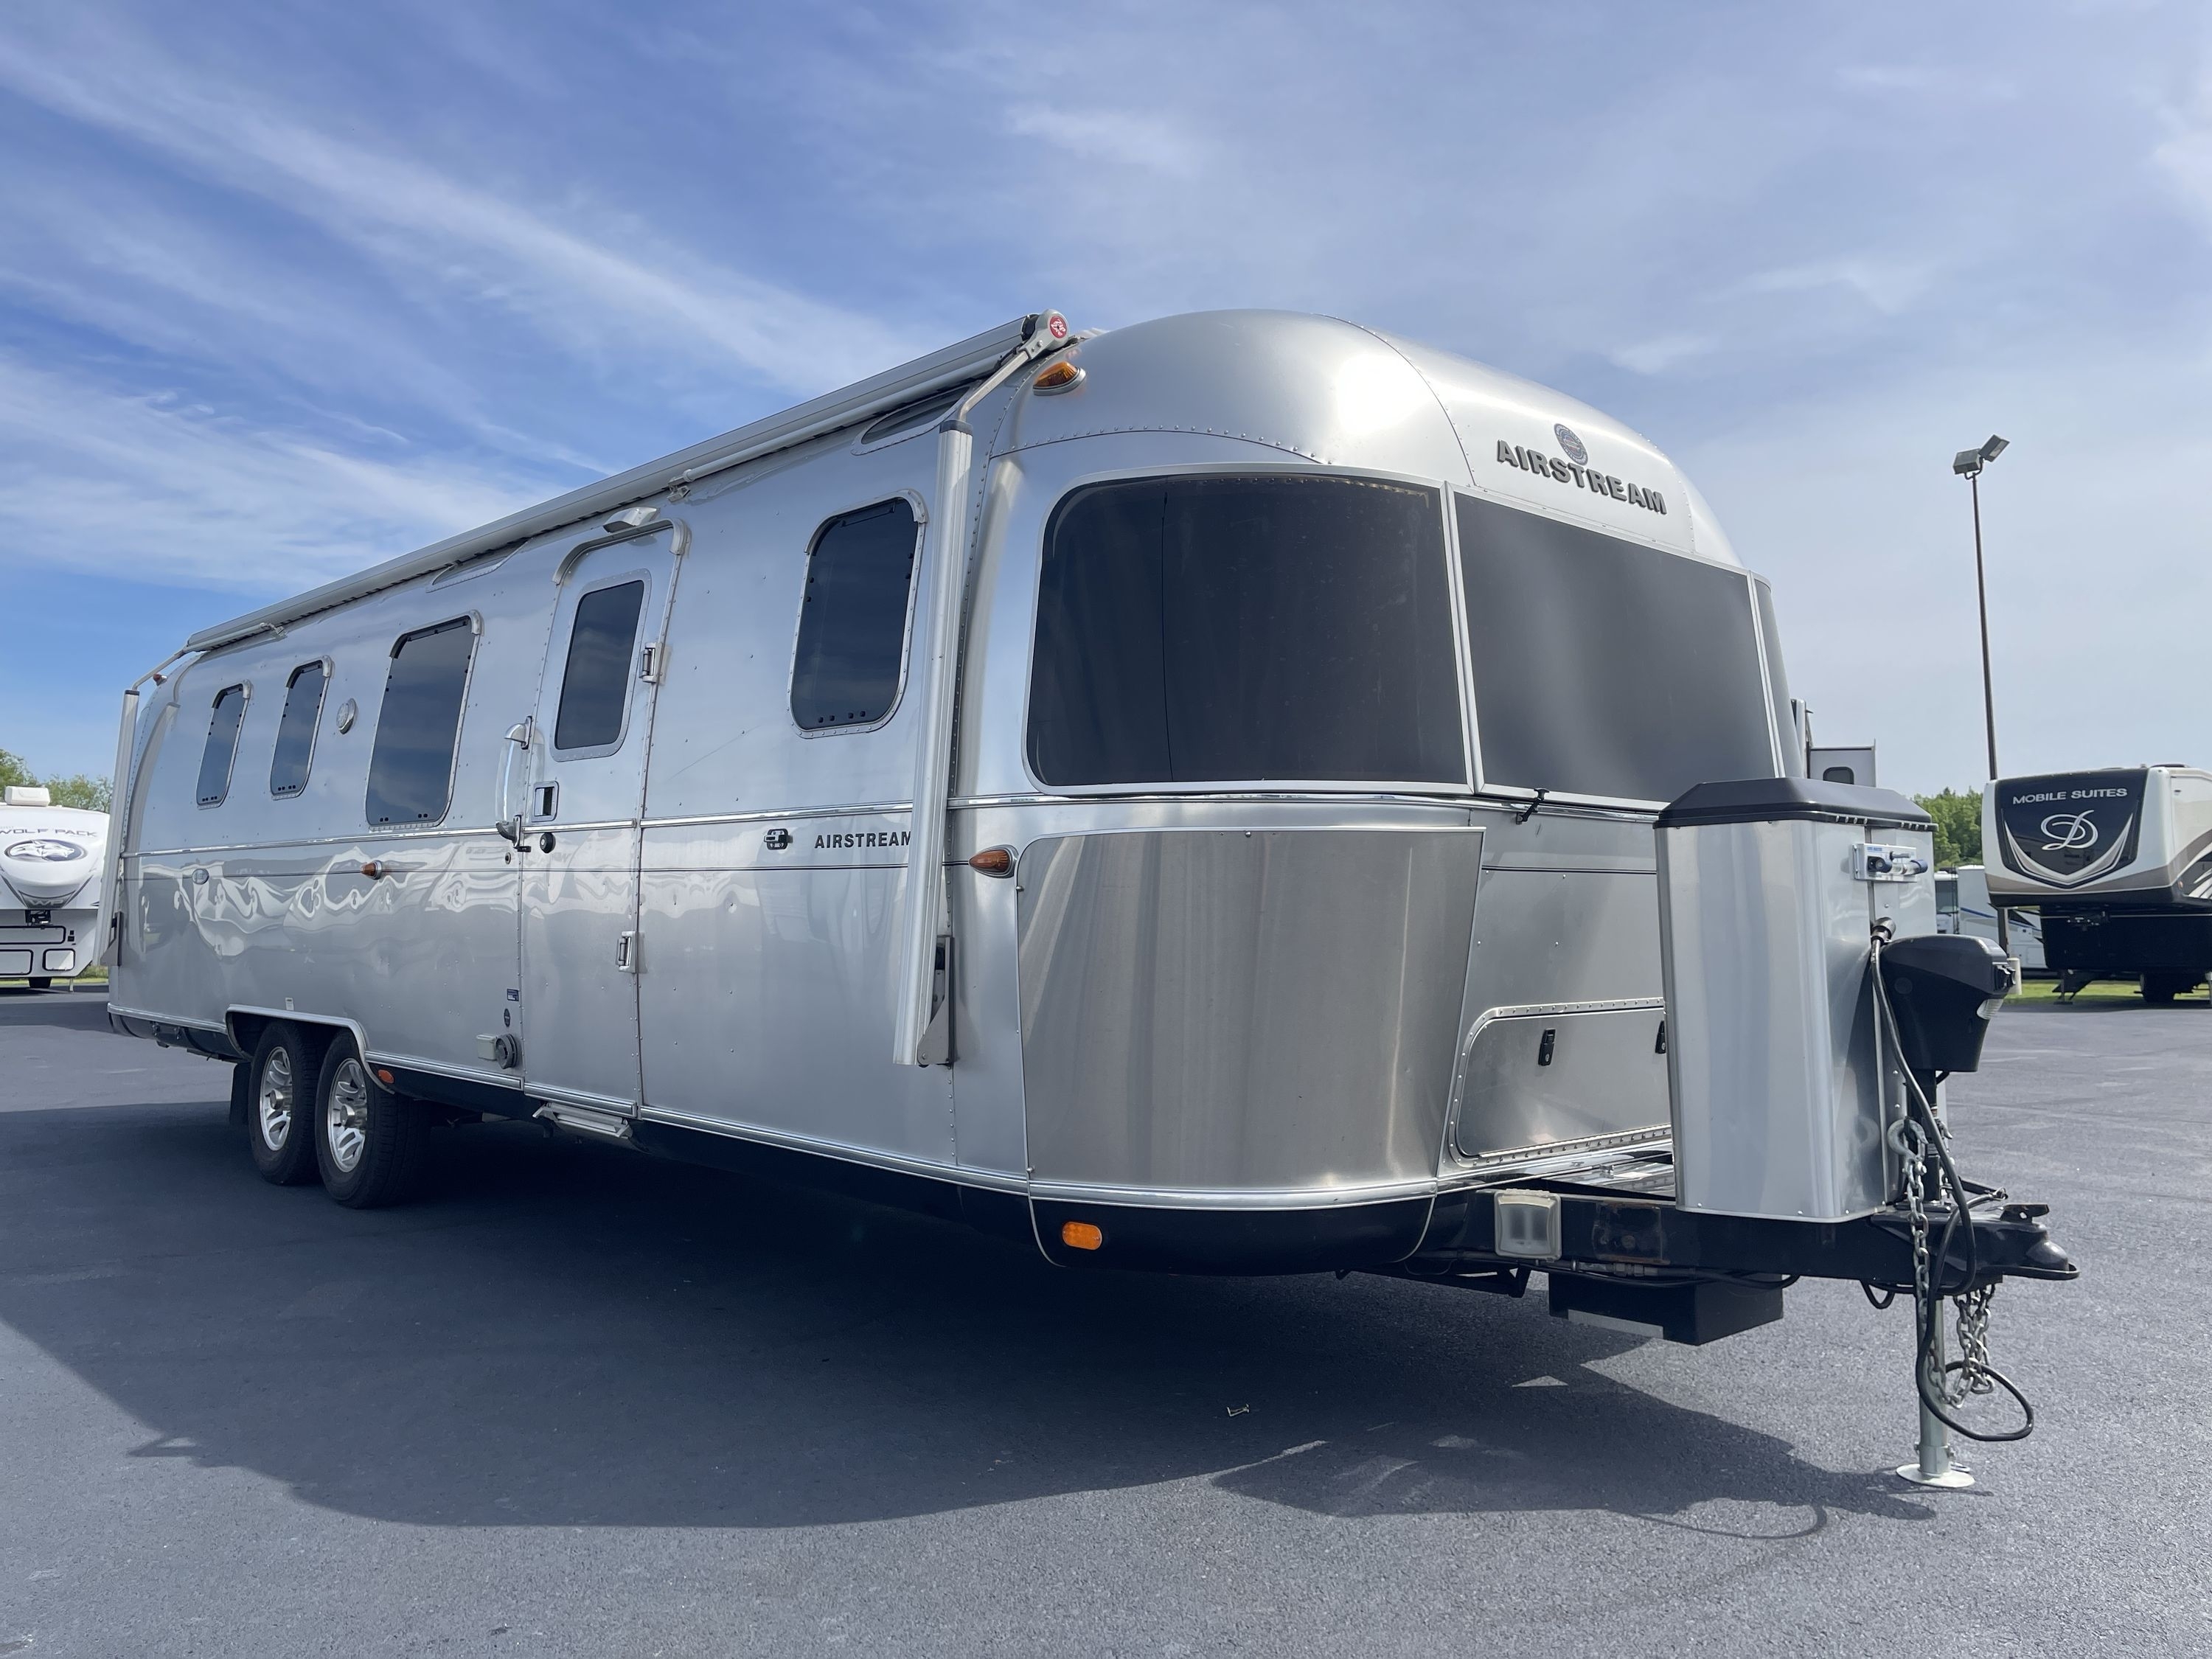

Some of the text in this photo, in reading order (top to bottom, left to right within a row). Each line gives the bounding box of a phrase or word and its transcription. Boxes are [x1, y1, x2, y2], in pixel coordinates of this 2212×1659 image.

[1497, 439, 1667, 515] AIRSTREAM
[2012, 787, 2128, 804] MOBILE SUITES
[55, 829, 97, 837] PACK
